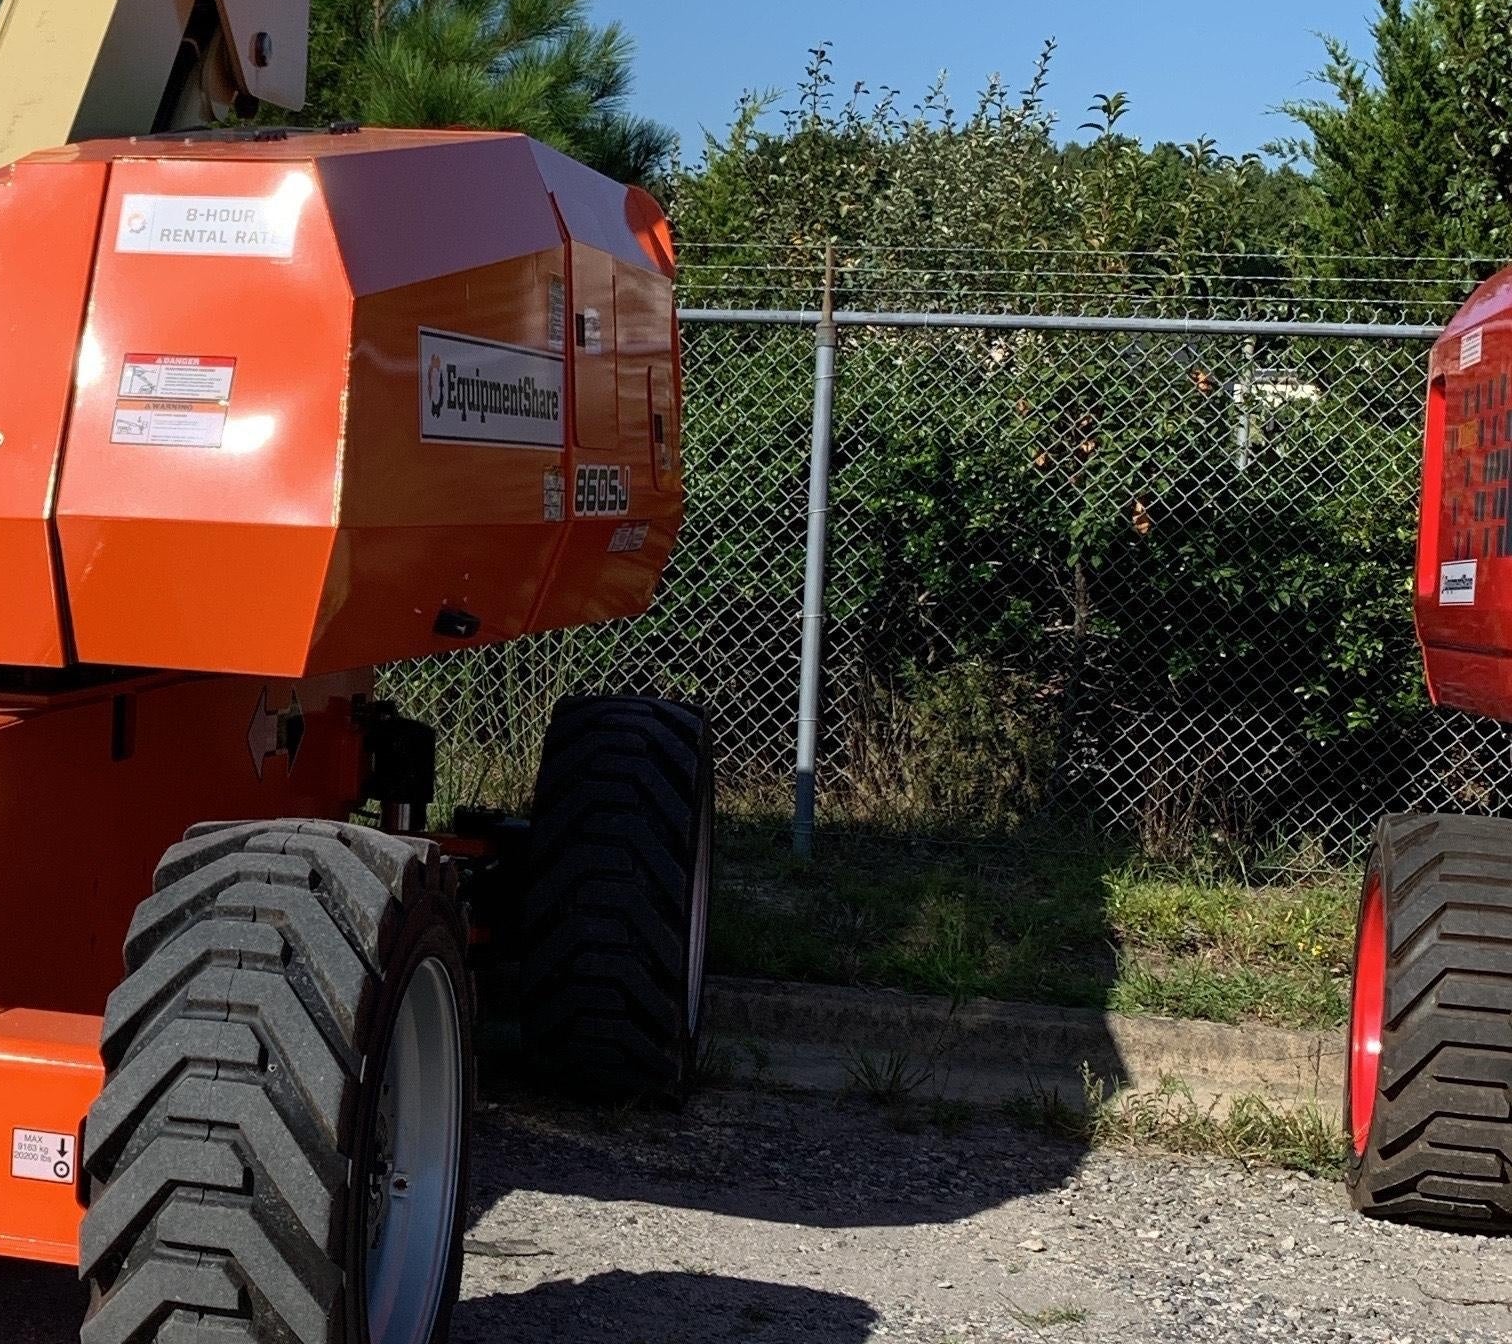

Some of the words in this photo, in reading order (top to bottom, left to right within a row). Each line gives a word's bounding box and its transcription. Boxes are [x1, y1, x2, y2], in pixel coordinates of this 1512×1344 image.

[186, 207, 256, 223] 8-HOUR
[159, 228, 228, 244] RENTAL
[163, 357, 200, 366] DANGER
[445, 363, 560, 424] EquipmentShare
[152, 403, 194, 411] WARNING
[574, 464, 631, 517] 860SJ
[24, 1134, 43, 1143] MAX
[13, 1150, 39, 1161] 20200
[40, 1153, 52, 1163] lbs
[39, 1145, 49, 1155] kg
